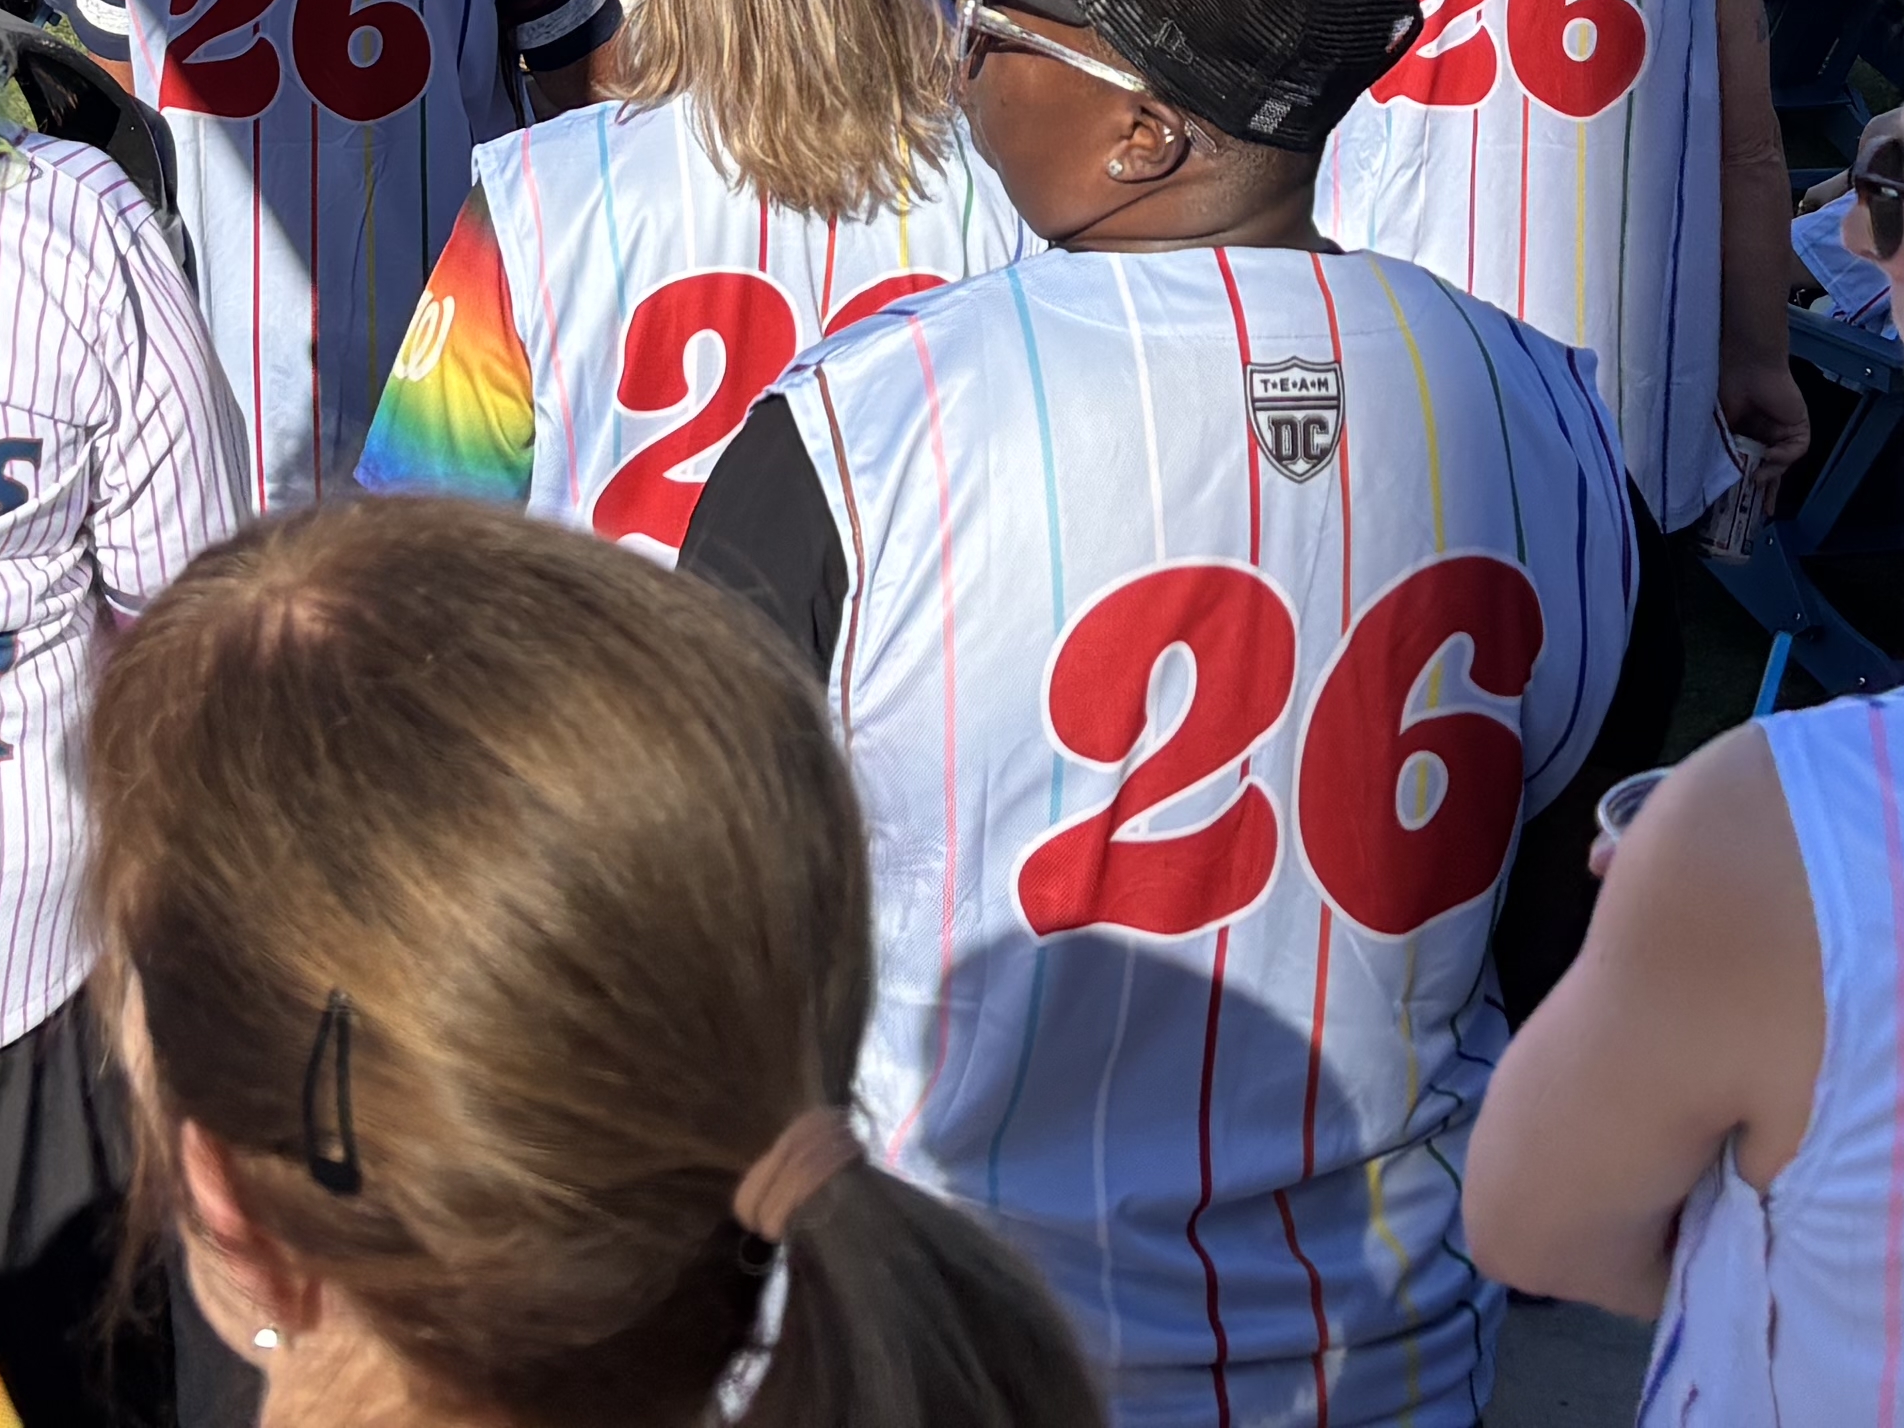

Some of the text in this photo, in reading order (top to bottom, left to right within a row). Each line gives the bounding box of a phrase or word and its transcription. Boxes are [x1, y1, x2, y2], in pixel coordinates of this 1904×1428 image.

[1260, 376, 1330, 393] TEAM
[1267, 414, 1332, 465] DC
[1012, 556, 1546, 940] 26
